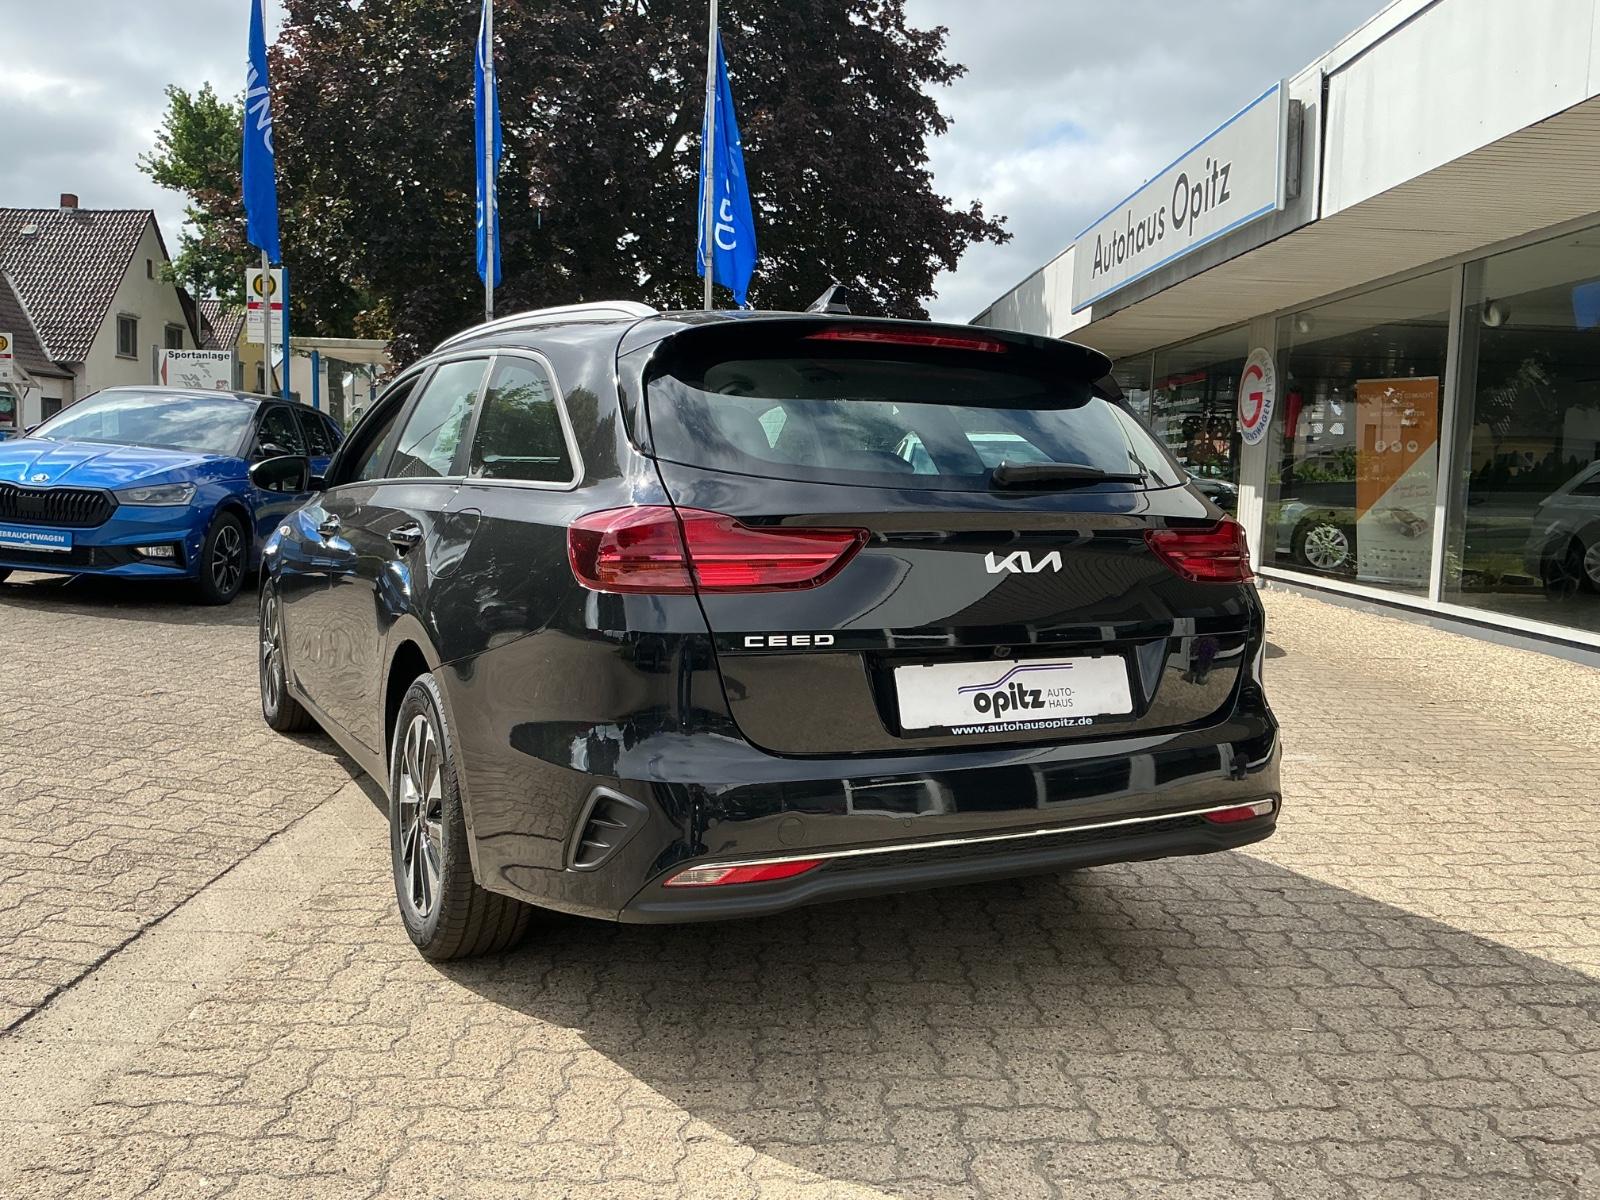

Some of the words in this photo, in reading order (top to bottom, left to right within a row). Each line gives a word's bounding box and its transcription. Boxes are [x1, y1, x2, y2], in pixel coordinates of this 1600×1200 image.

[1092, 204, 1166, 279] Autohaus
[1171, 157, 1233, 236] Opitz
[168, 351, 231, 361] Sportanlage
[1240, 364, 1264, 428] G
[0, 530, 65, 543] EBRAUCHTWAGEN
[984, 550, 1063, 575] KIA
[743, 633, 836, 648] CEED
[973, 682, 1046, 719] opitz
[1047, 687, 1076, 698] AUTO-
[1048, 698, 1074, 709] HAUS
[951, 715, 1094, 736] www.autohausopitz.de
